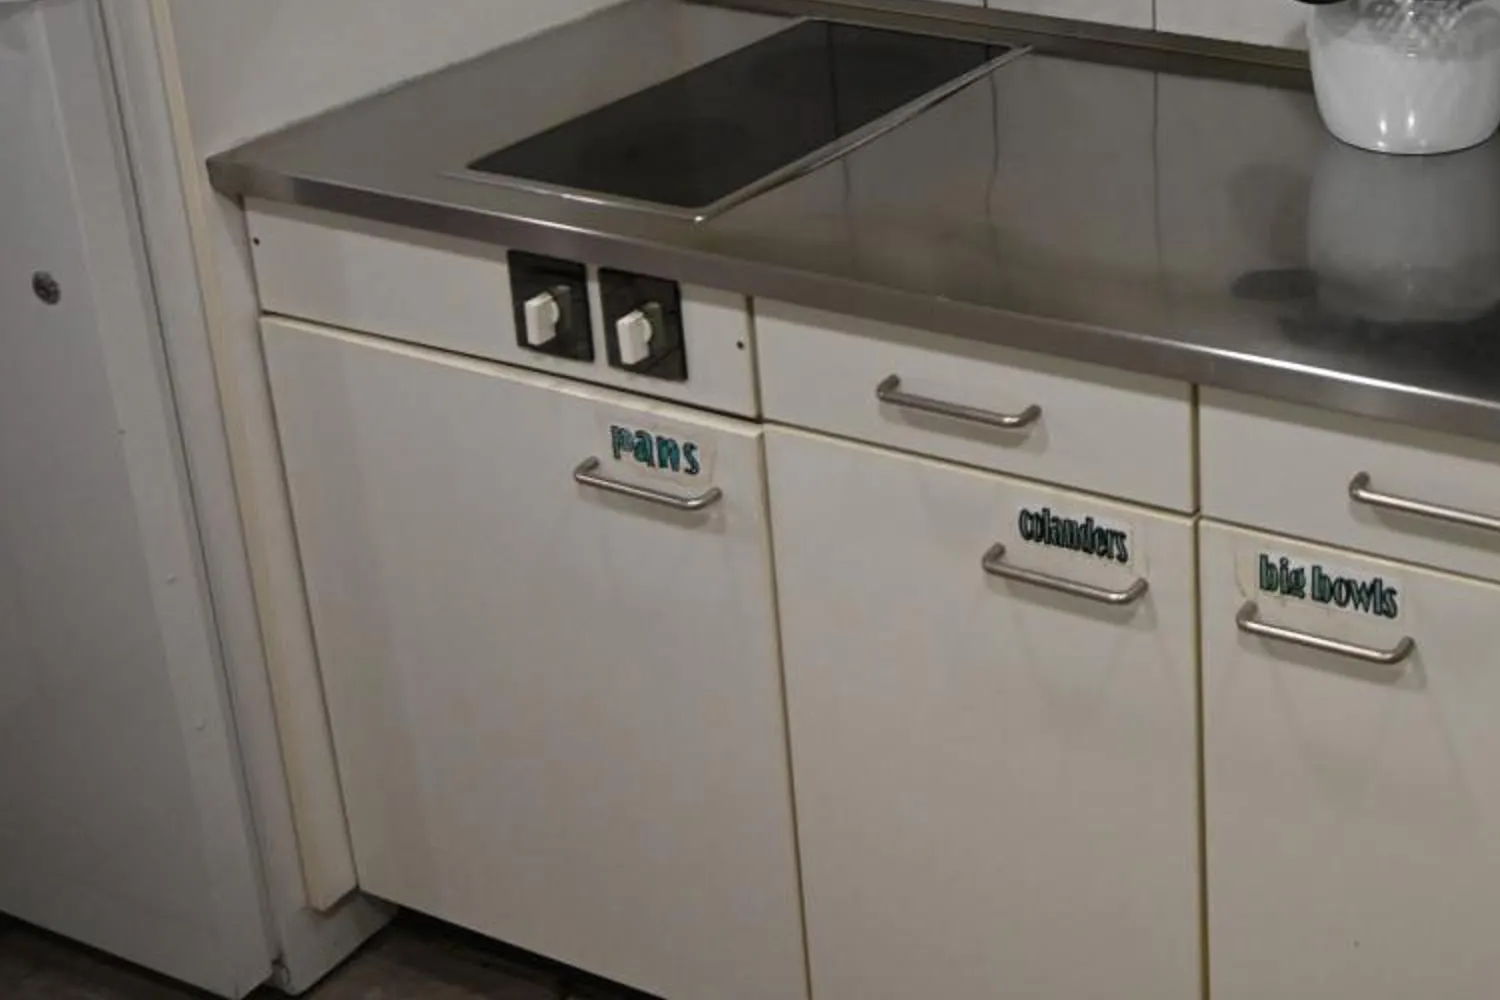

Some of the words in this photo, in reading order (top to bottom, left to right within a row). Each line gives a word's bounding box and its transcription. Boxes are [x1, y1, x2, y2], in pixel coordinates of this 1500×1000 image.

[610, 425, 700, 475] pans
[1018, 507, 1128, 563] colanders
[1259, 553, 1306, 599] big
[1311, 564, 1398, 619] bowls
